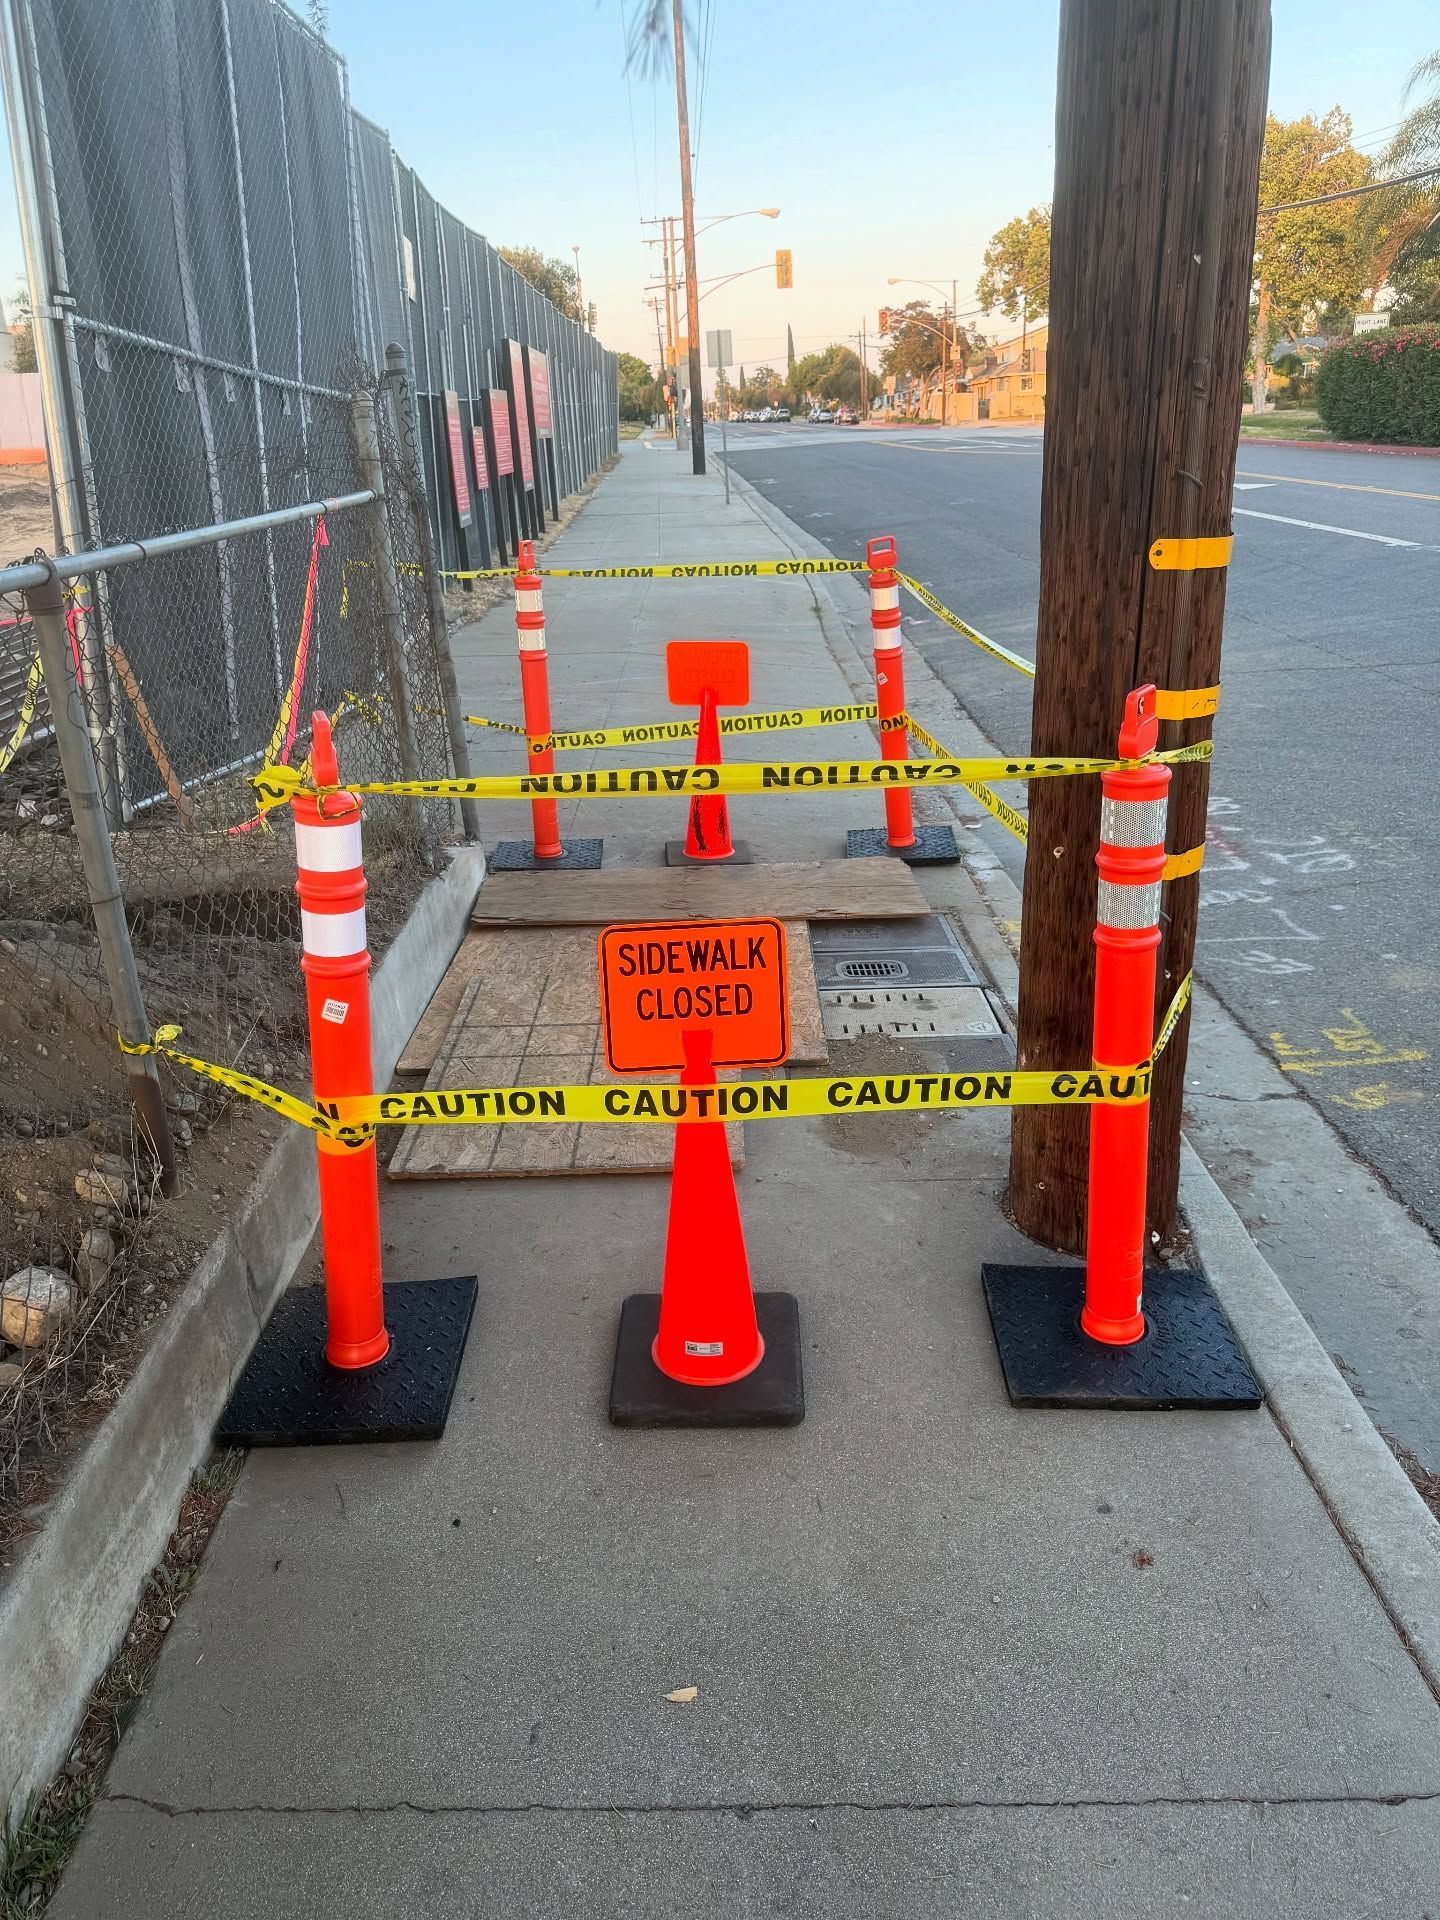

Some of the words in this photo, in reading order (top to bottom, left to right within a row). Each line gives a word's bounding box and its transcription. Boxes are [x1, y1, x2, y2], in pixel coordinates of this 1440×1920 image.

[520, 768, 720, 793] CAUTION
[762, 763, 961, 788] CAUTION
[618, 936, 767, 977] SIDEWALK
[636, 983, 753, 1021] CLOSED
[380, 1090, 566, 1119] CAUTION
[604, 1085, 788, 1118] CAUTION
[827, 1075, 1012, 1108] CAUTION
